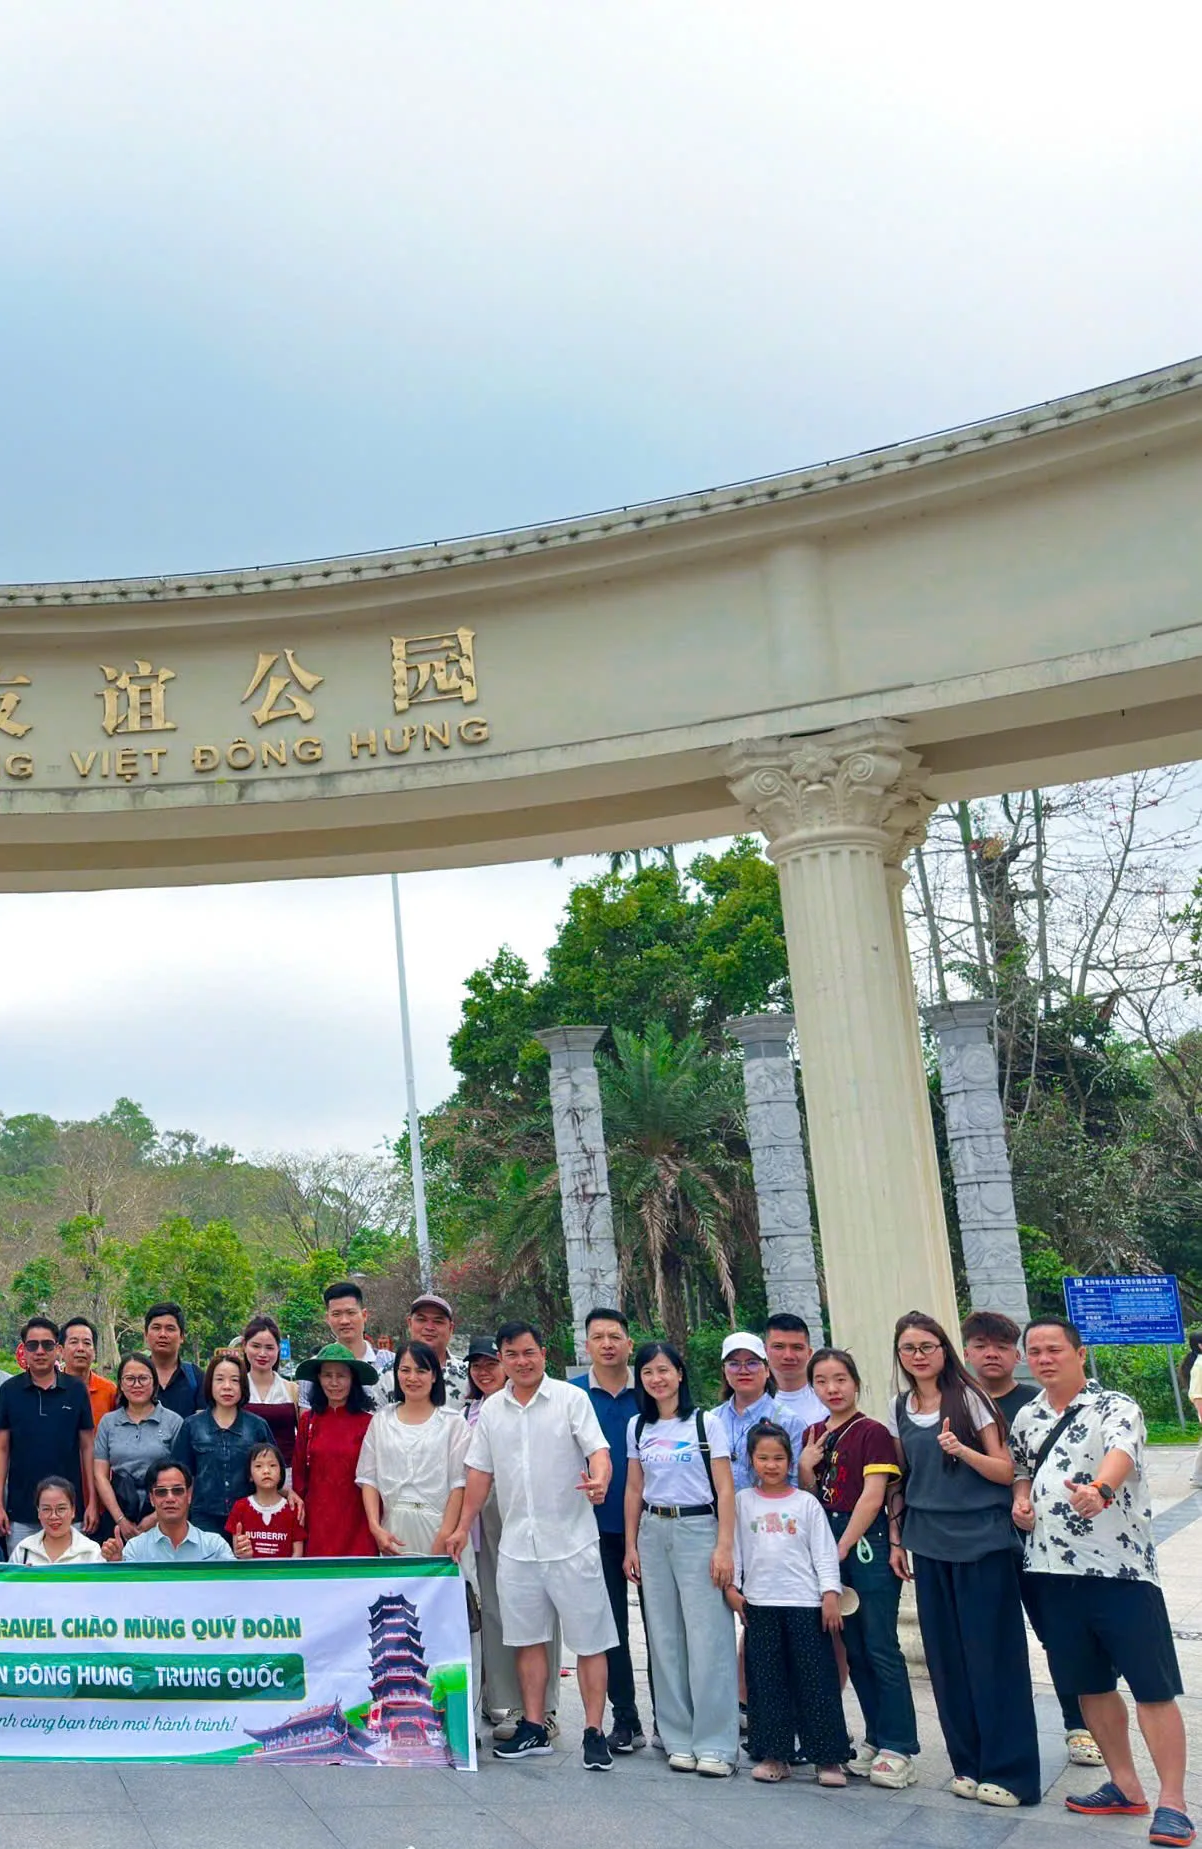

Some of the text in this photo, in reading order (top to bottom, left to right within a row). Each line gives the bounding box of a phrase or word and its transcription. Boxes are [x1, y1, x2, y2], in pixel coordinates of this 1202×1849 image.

[70, 746, 168, 784] VIỆT
[192, 736, 324, 771] ĐÔNG
[350, 716, 490, 758] HƯNG
[245, 1530, 288, 1541] BURBERRY
[62, 1614, 118, 1639] CHÀO
[124, 1614, 186, 1639] MỪNG
[191, 1614, 237, 1640] QUÝ
[242, 1614, 303, 1639] ĐOÀN
[14, 1663, 71, 1685] ĐÔNG
[155, 1665, 221, 1687] TRUNG
[227, 1661, 285, 1688] QUỐC
[20, 1713, 56, 1735] cùng
[57, 1714, 87, 1732] bạn
[89, 1716, 119, 1730] trên
[152, 1715, 192, 1731] hành
